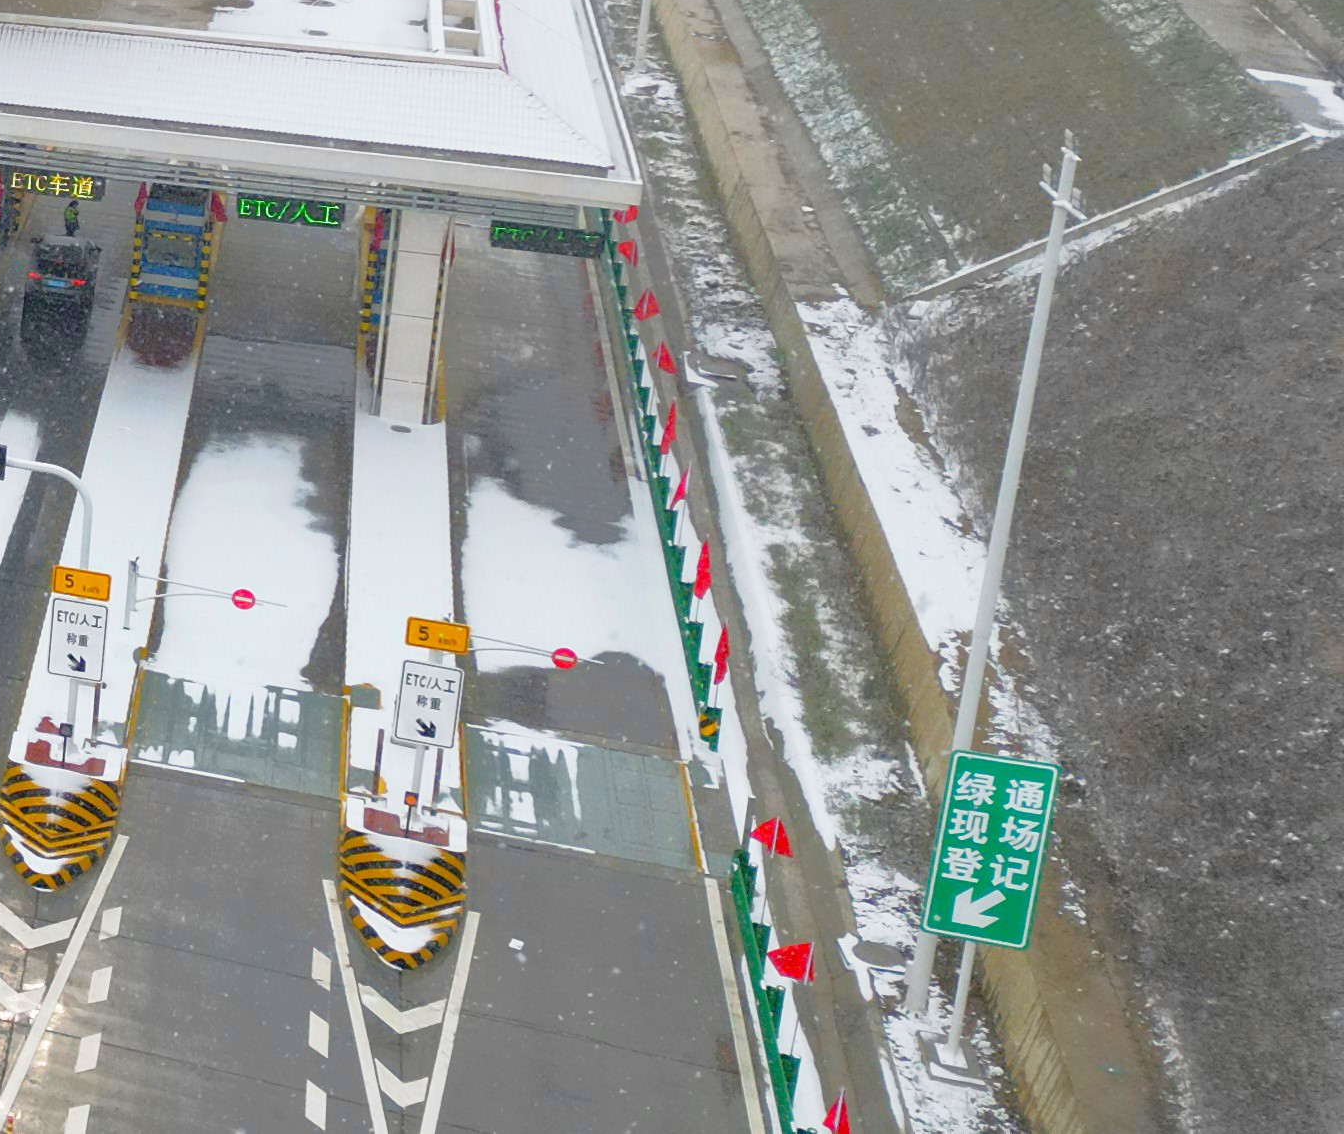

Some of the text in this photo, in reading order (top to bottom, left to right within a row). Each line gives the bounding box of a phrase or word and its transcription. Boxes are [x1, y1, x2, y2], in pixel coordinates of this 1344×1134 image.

[11, 172, 94, 199] ETC车道
[239, 198, 340, 225] ETC/人工
[64, 573, 75, 589] 5
[56, 610, 103, 629] ETC/人工
[418, 625, 430, 642] 5
[405, 672, 457, 694] ETC/人工
[952, 770, 1046, 815] 绿通
[947, 807, 1041, 853] 现场
[940, 845, 1030, 892] 登记
